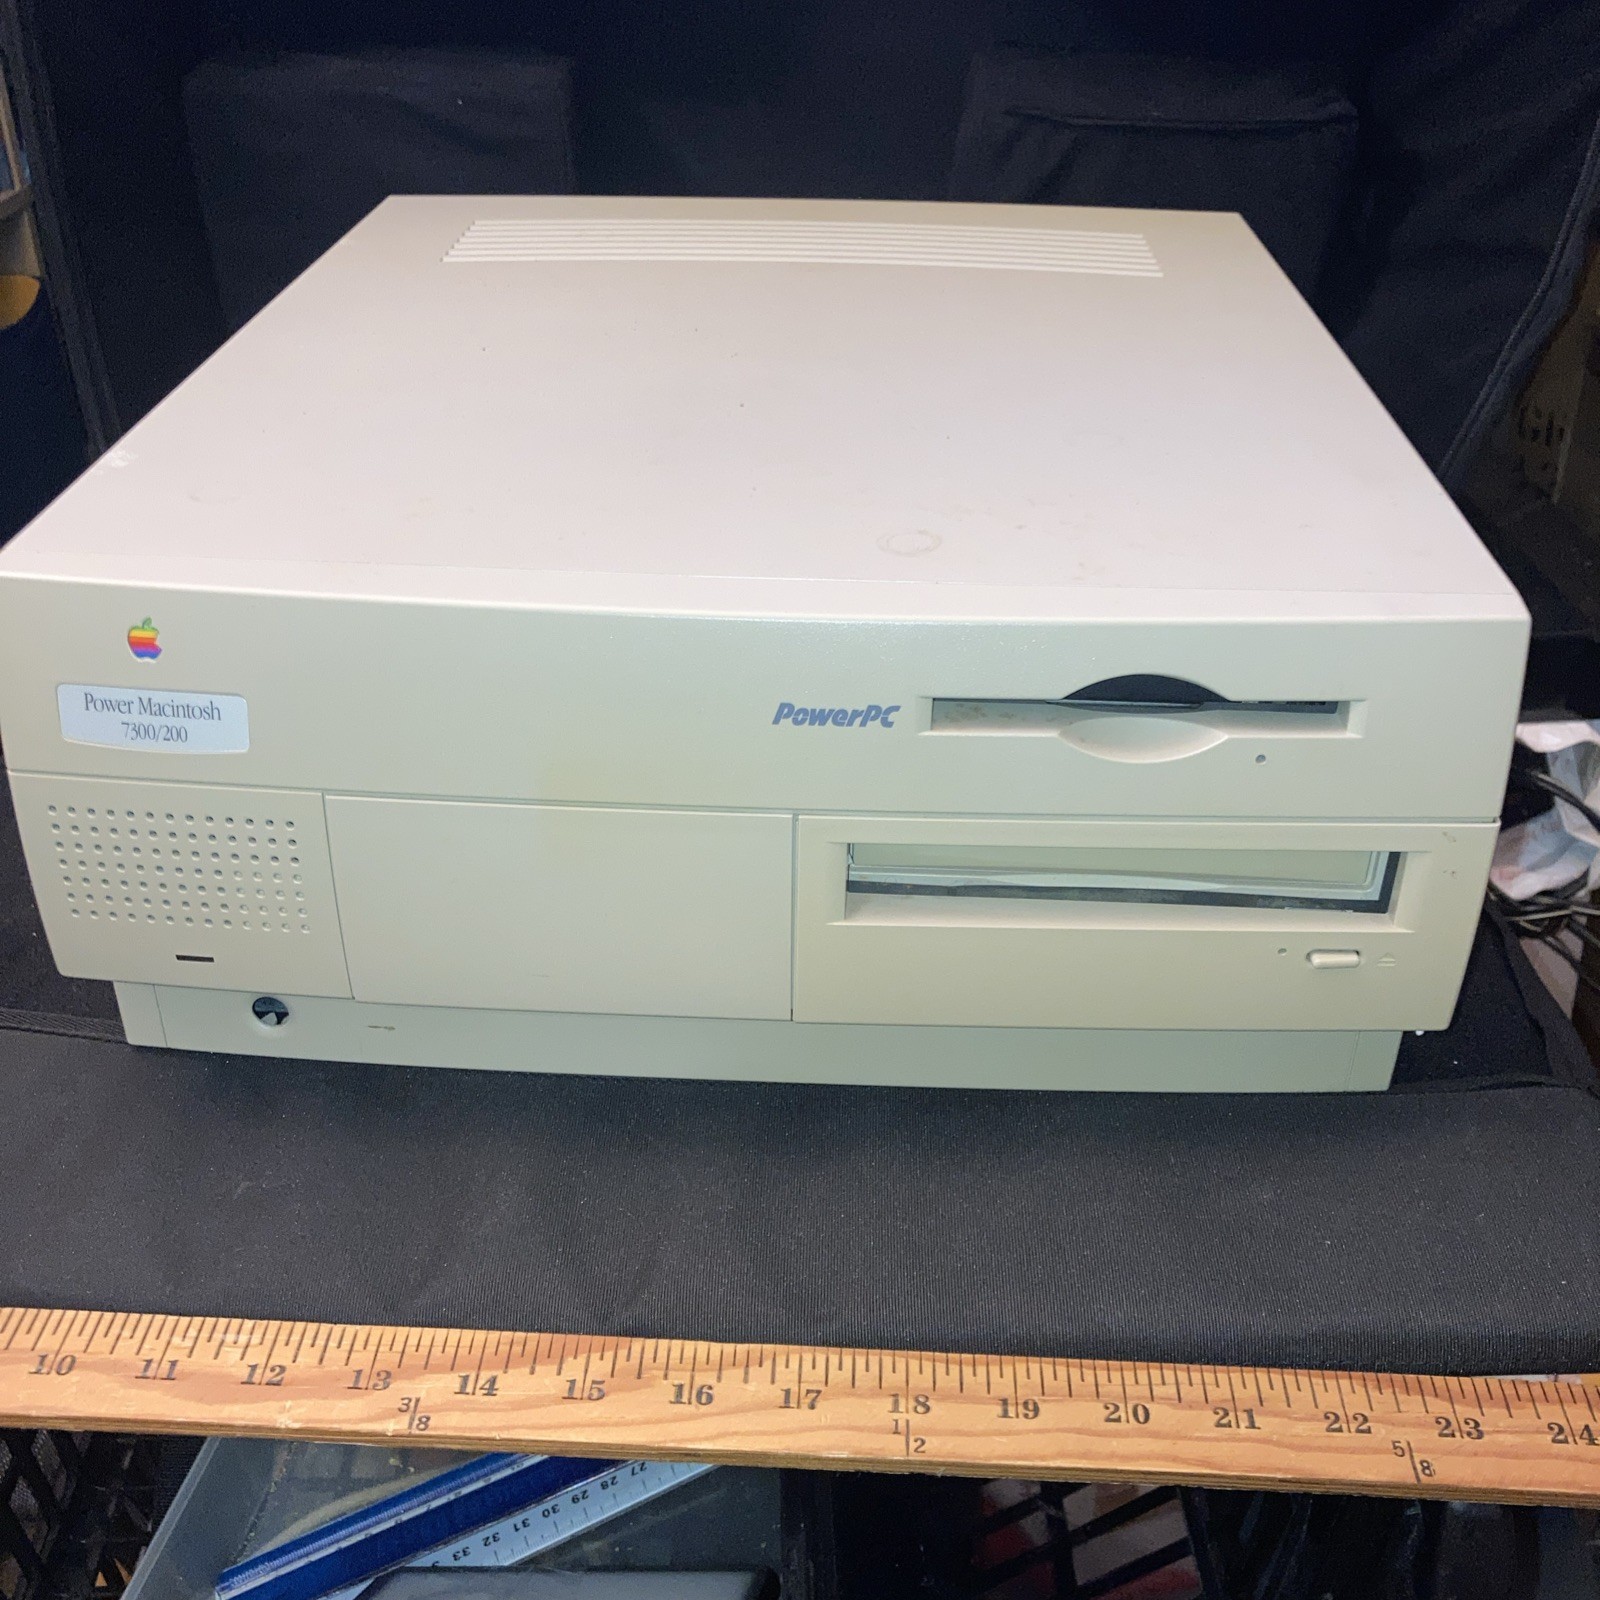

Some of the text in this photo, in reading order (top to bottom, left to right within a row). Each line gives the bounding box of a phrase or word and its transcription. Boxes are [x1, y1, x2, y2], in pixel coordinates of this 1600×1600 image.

[84, 692, 221, 721] Power Macintosh
[772, 702, 901, 728] PowerPC
[121, 722, 188, 743] 7300/200
[29, 1354, 1599, 1447] 10 11 12 13 14 15 16 17 18 19 20 21 22 23 24
[452, 1461, 647, 1561] 27 28 29 30 31 32 33
